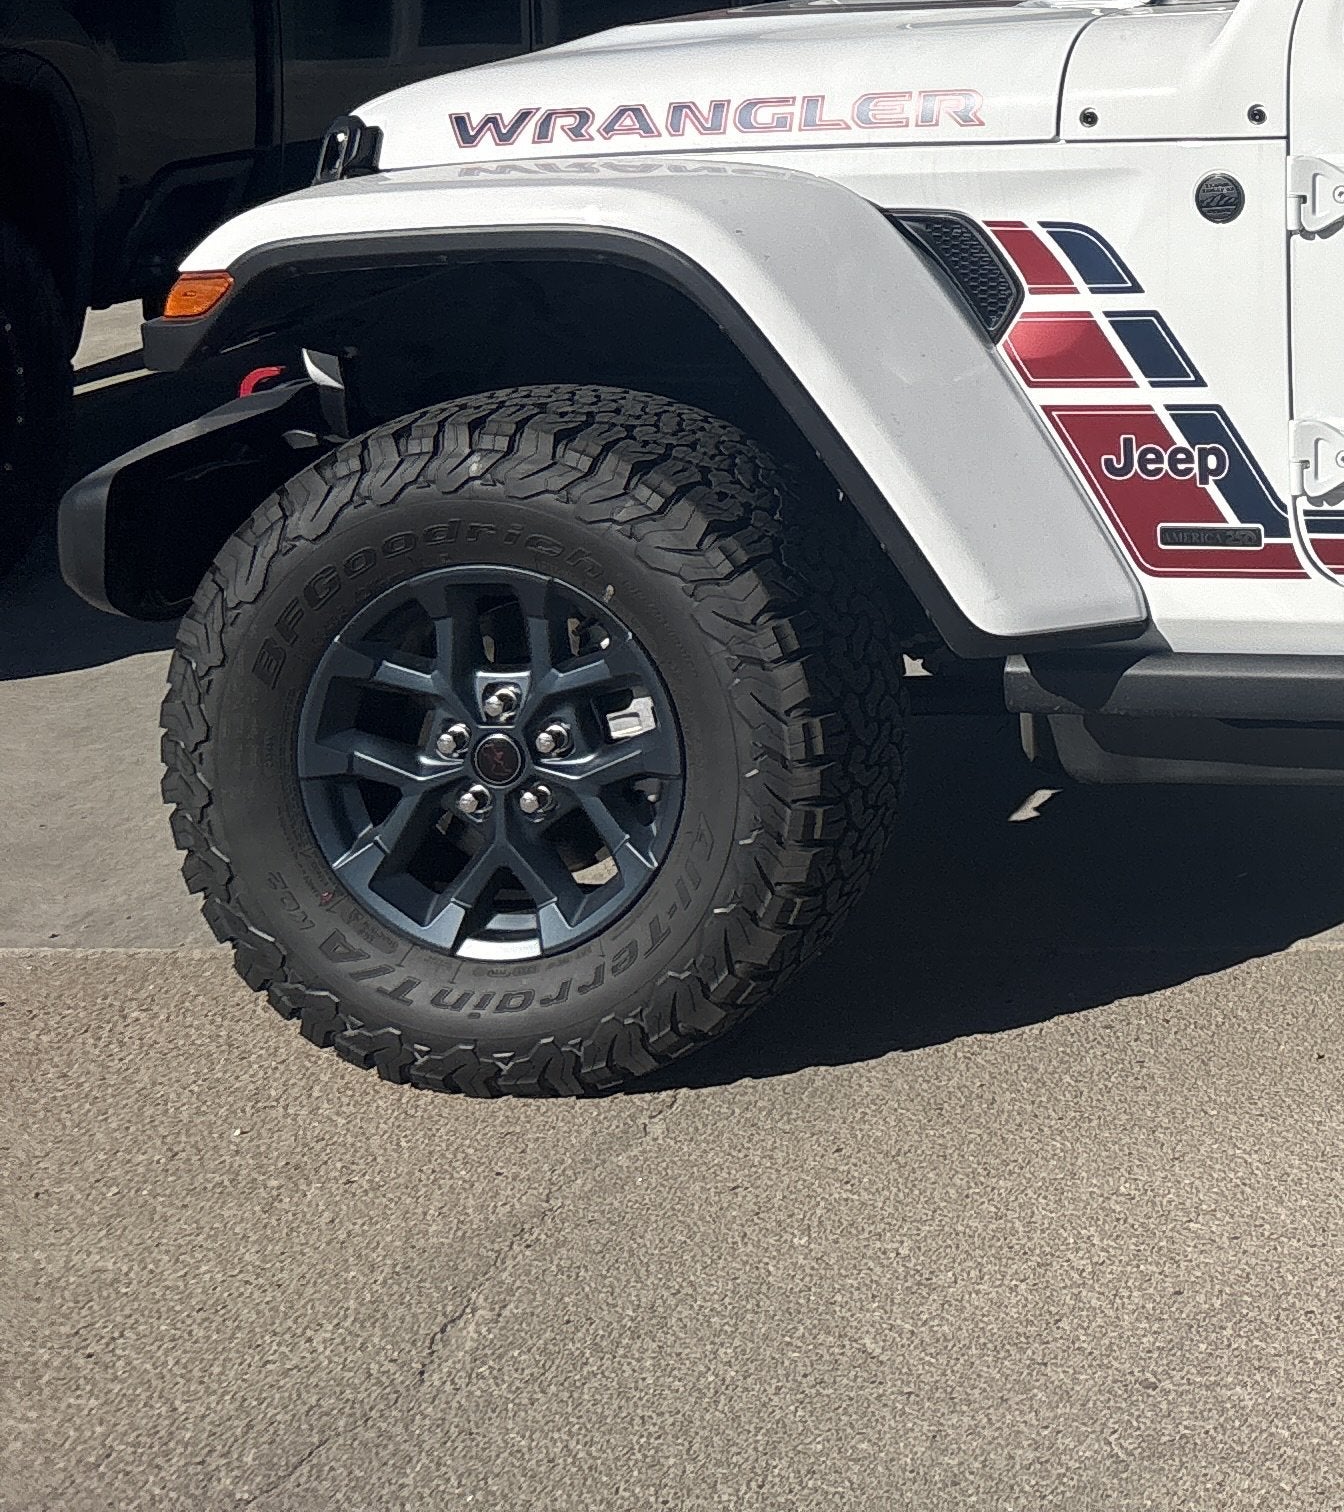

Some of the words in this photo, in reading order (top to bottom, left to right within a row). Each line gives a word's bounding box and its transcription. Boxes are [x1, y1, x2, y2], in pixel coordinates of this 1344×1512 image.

[447, 88, 986, 149] WRANGLER
[1102, 436, 1230, 487] Jeep
[1163, 530, 1223, 544] AMERICA
[251, 516, 606, 689] BFGoodrich
[430, 808, 719, 1021] All-Terrain
[317, 926, 425, 1009] T/A
